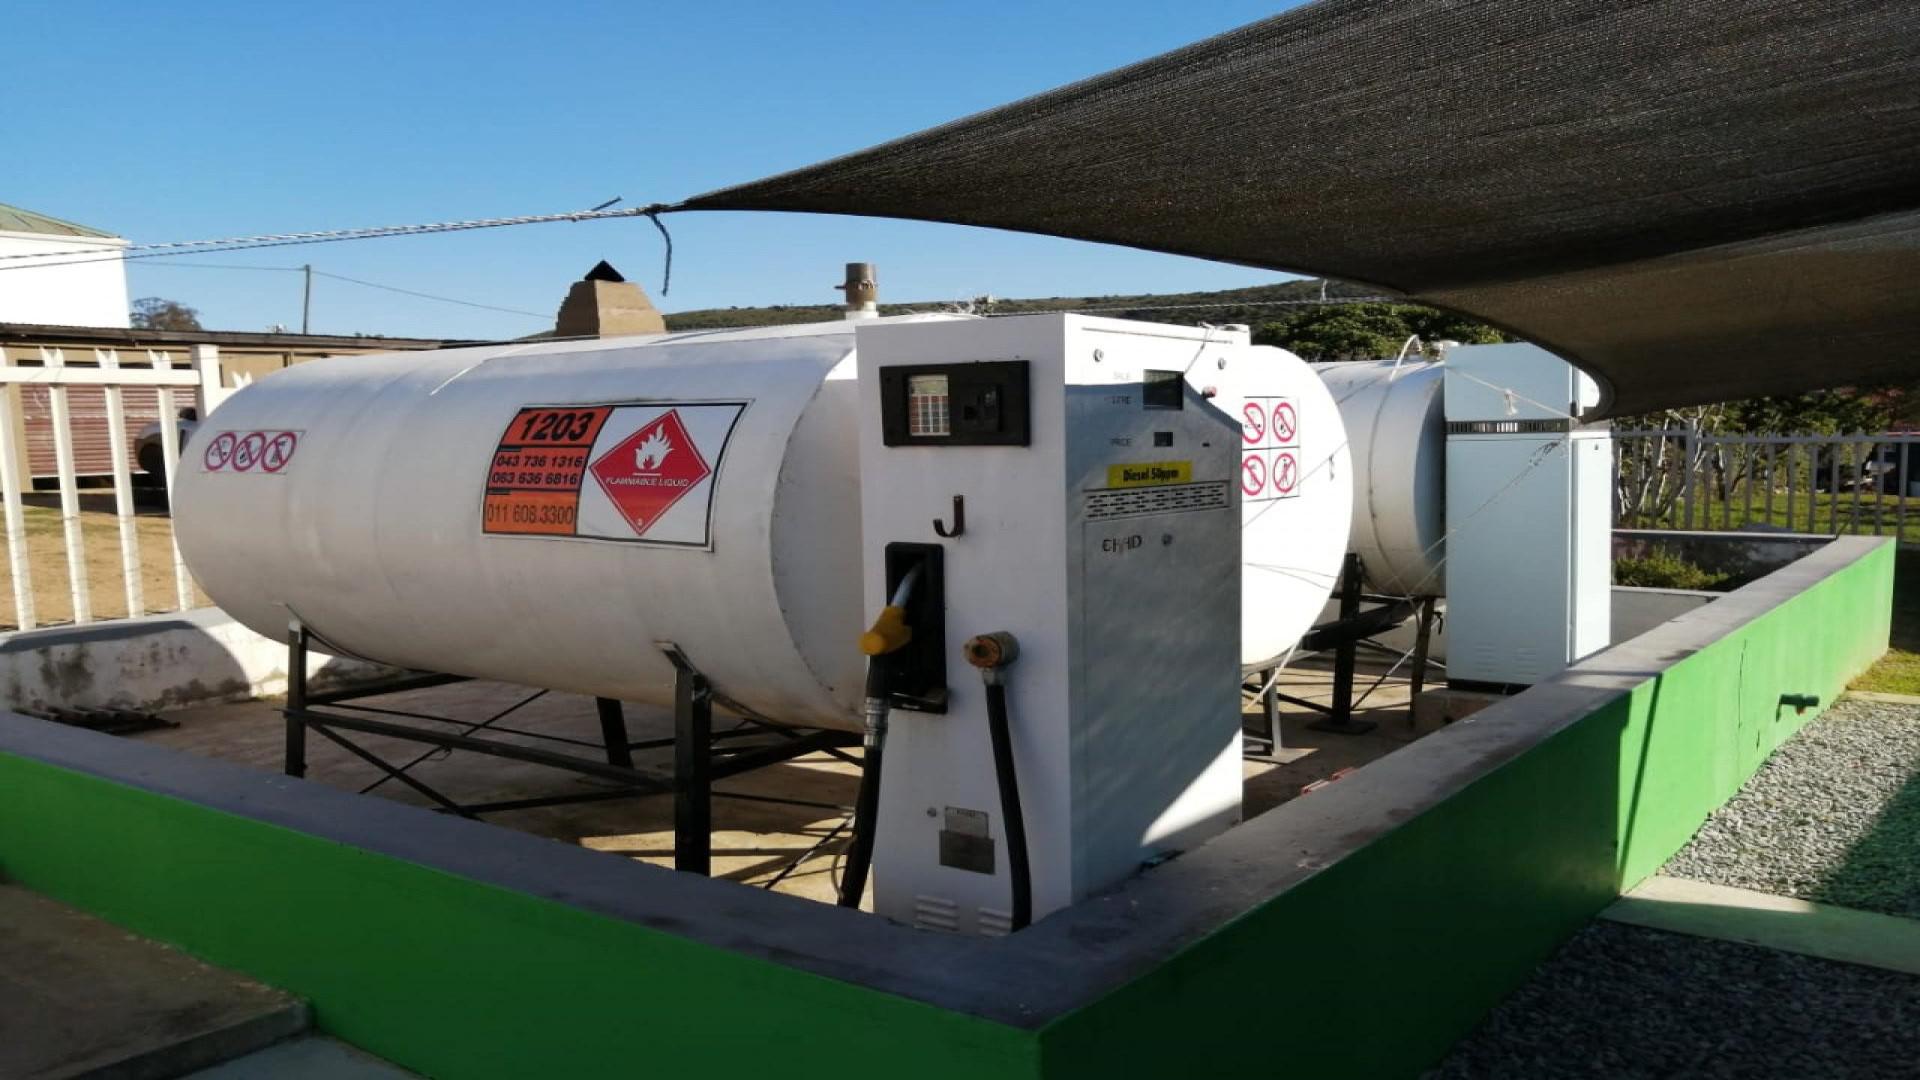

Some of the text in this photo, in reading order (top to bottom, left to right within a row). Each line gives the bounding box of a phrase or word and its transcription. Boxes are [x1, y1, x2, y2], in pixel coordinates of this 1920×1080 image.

[520, 411, 596, 441] 1203
[496, 455, 520, 467] 043
[551, 456, 585, 468] 1316
[545, 472, 578, 485] 6816
[1123, 466, 1179, 482] Diesel 50ppm
[606, 476, 690, 488] FLAMMABLE LIQUID
[487, 503, 574, 525] 011 608 3300
